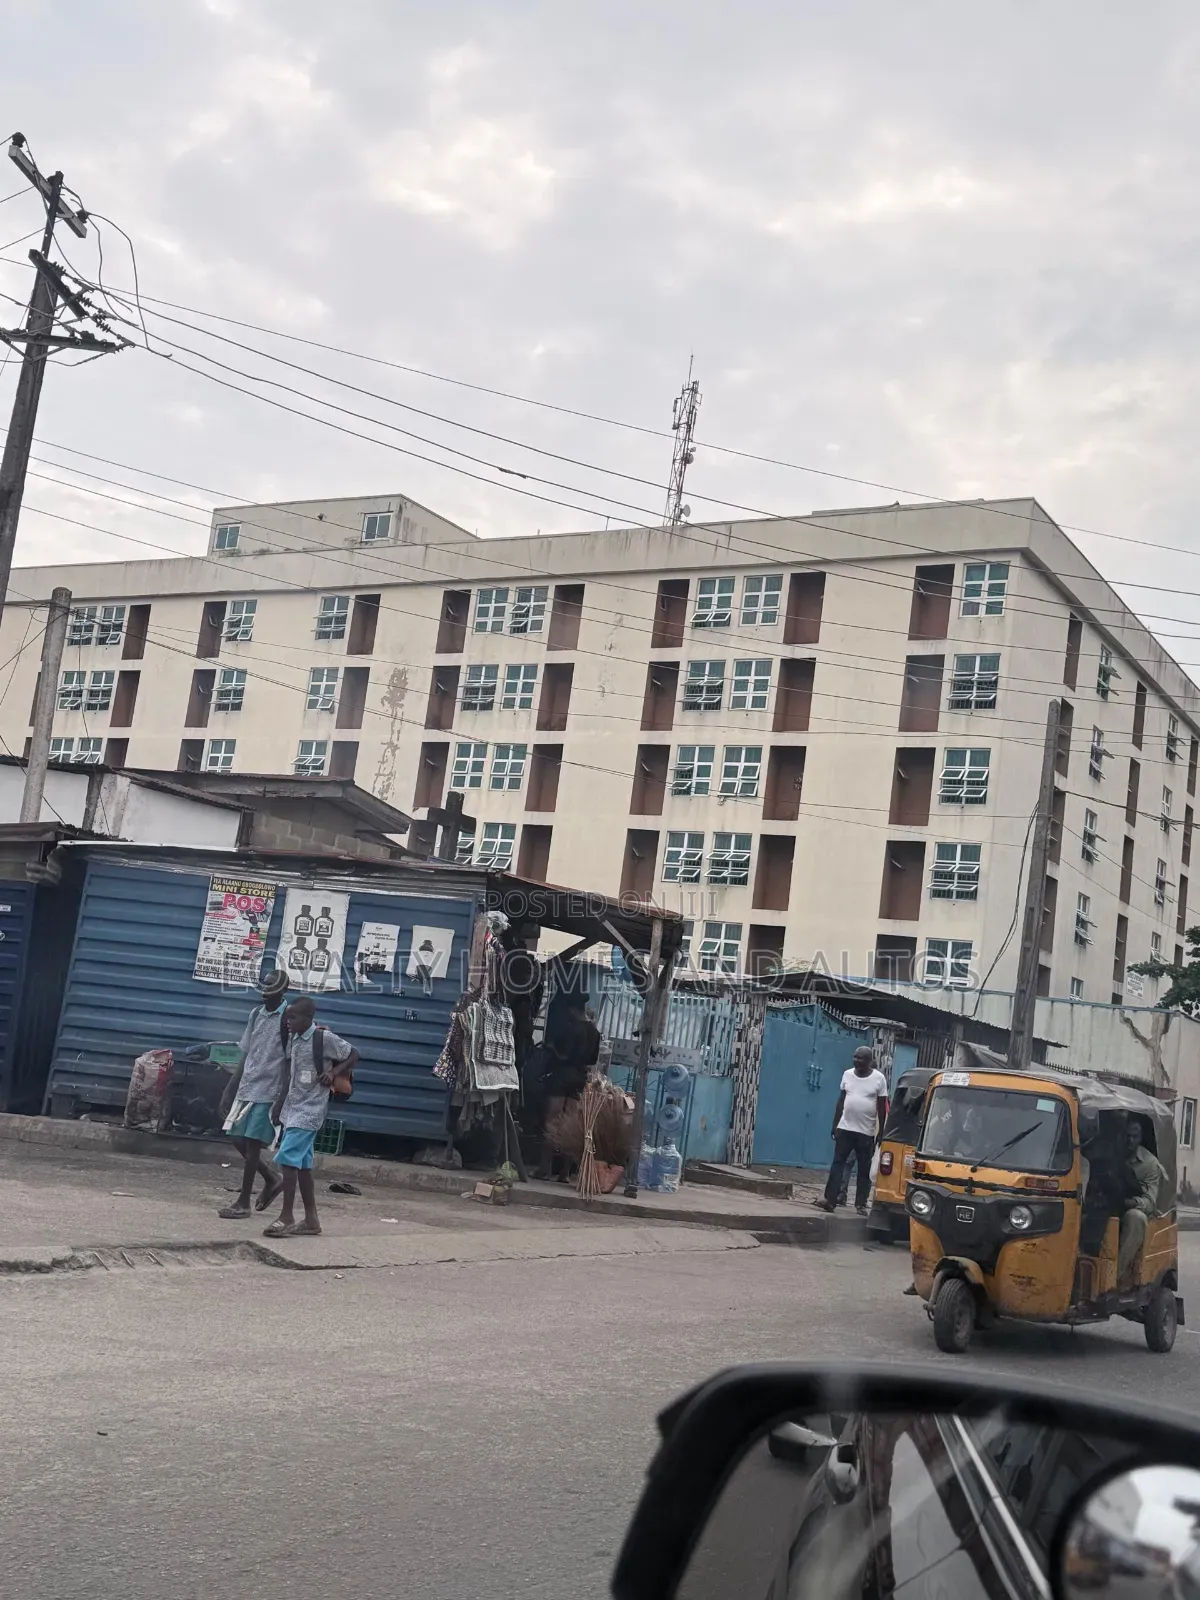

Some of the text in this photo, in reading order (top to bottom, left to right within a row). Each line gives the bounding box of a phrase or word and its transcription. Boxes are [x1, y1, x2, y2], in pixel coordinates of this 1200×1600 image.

[212, 884, 276, 898] MINI STORE
[222, 893, 266, 913] POS
